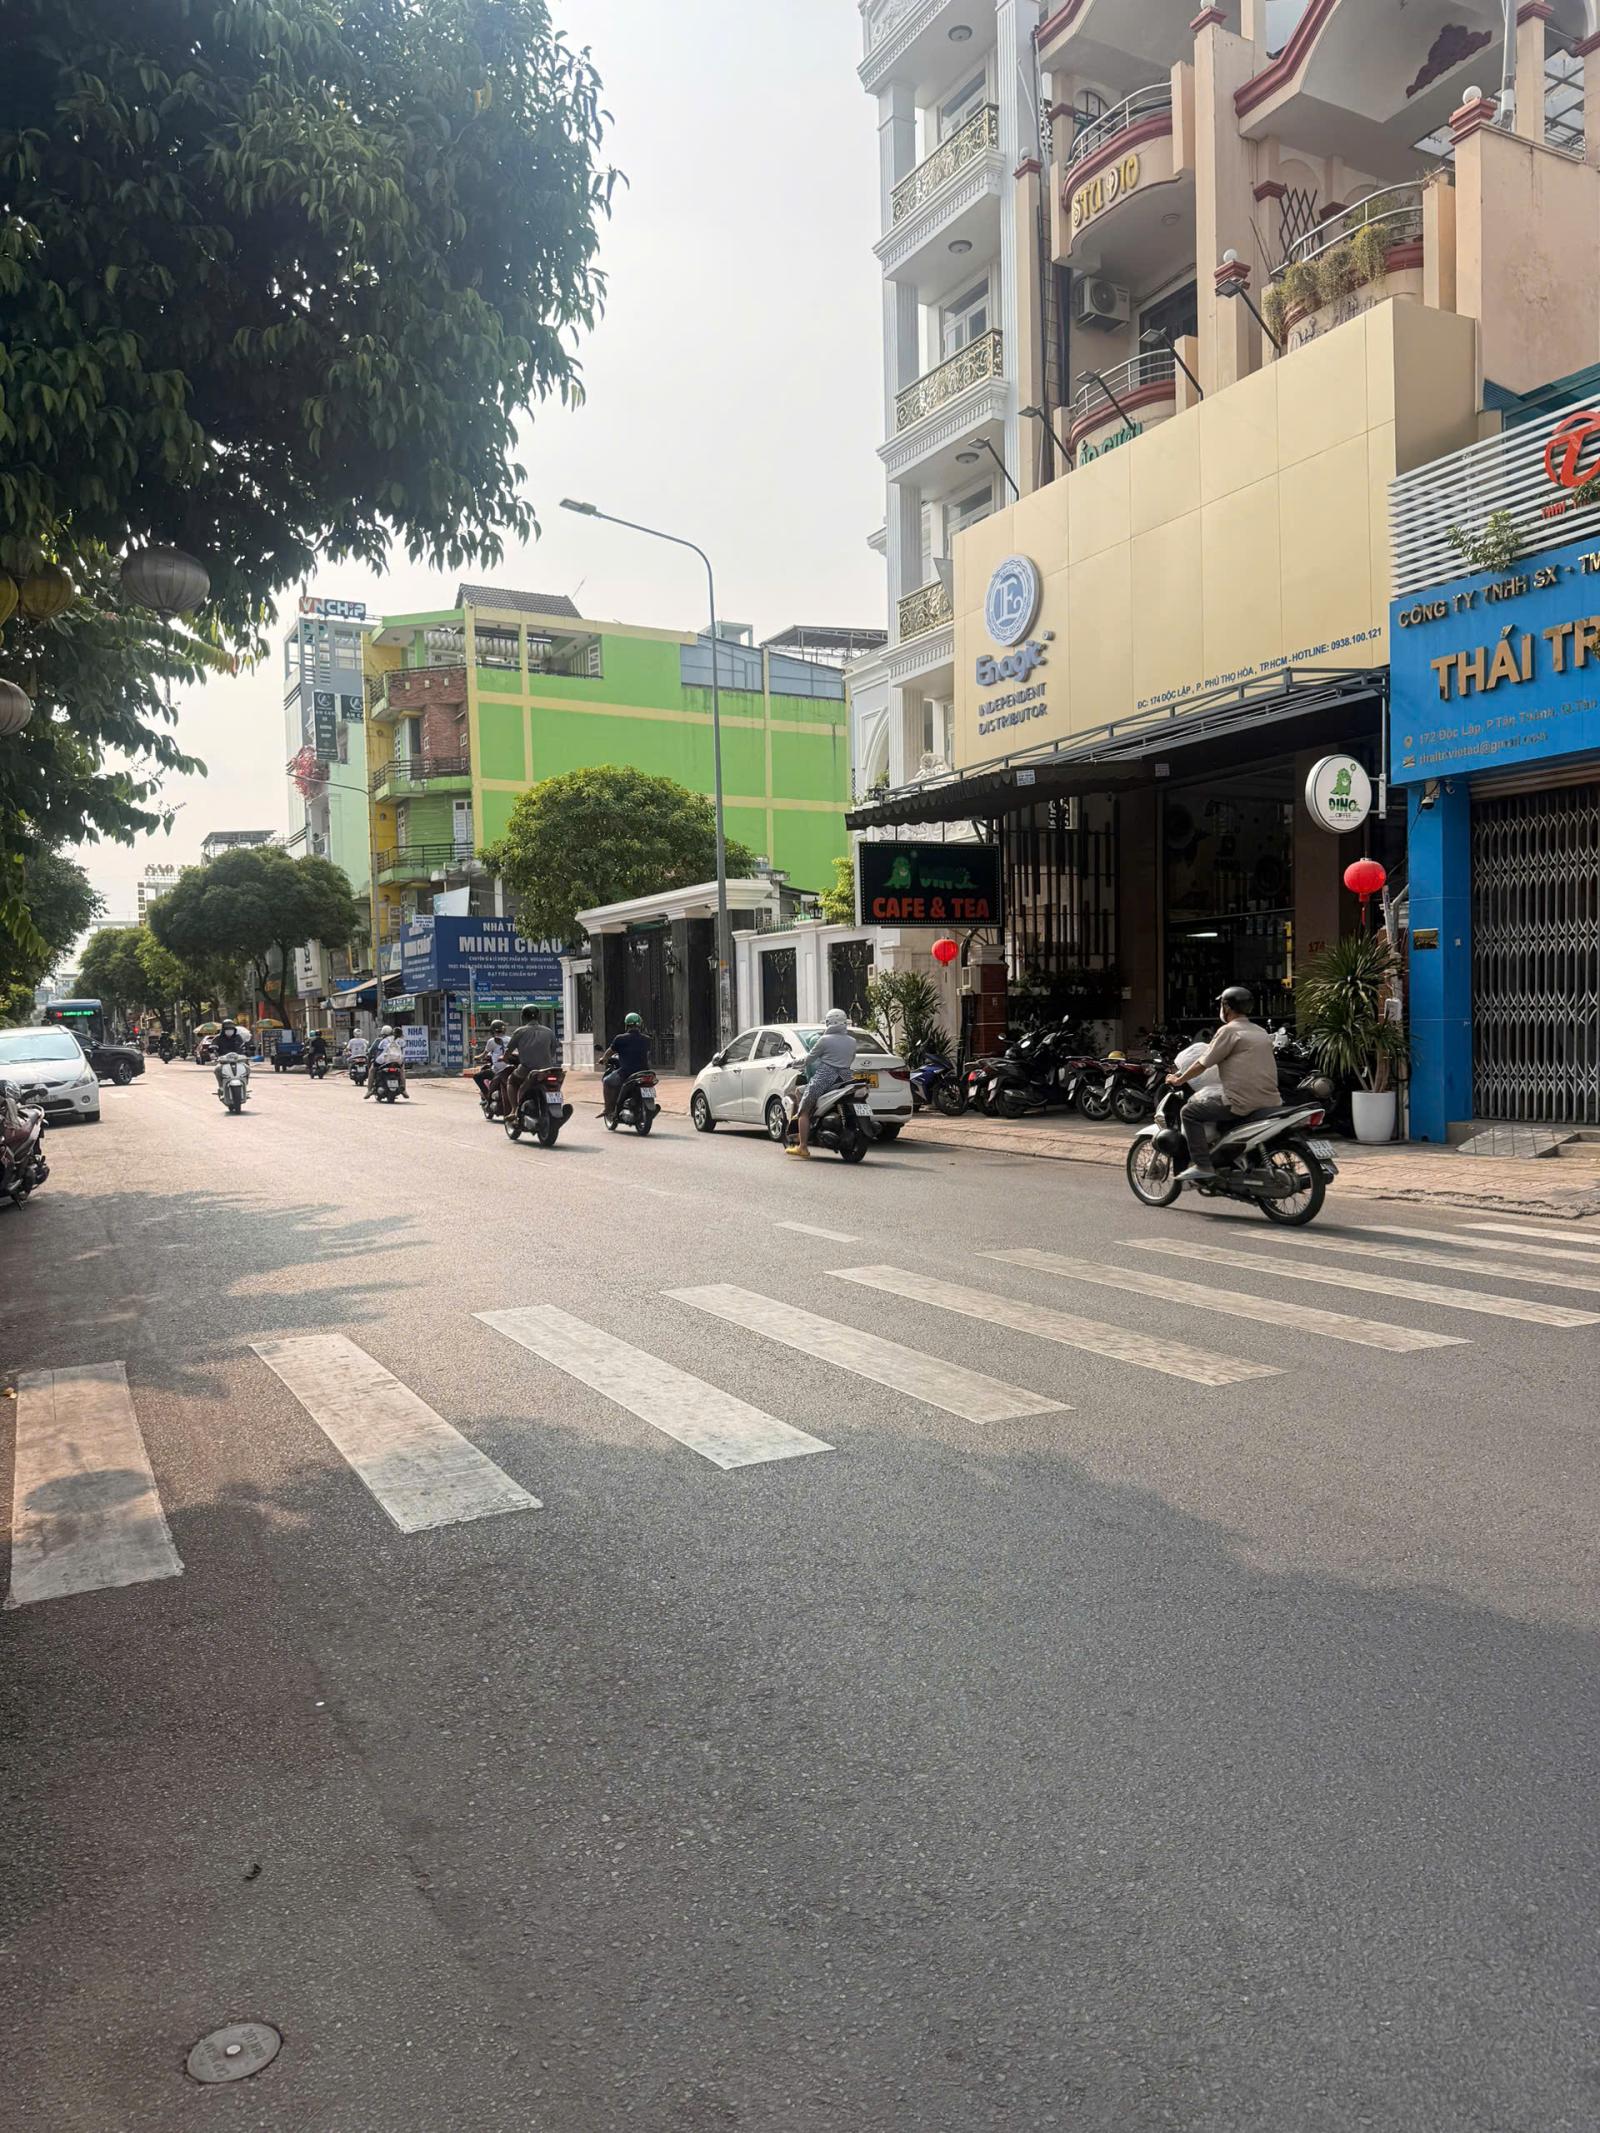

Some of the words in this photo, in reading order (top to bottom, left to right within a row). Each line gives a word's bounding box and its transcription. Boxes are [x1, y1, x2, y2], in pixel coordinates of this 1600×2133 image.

[1452, 590, 1476, 612] TY
[1482, 575, 1528, 604] TNHH
[1533, 564, 1560, 589] SX
[975, 640, 1049, 686] Enagic
[1150, 696, 1161, 705] 174
[1292, 644, 1330, 662] HOTLINE:
[1330, 627, 1382, 651] 0938.100.121
[1431, 623, 1534, 701] THÁI
[978, 682, 1047, 717] INDEPENDENT
[978, 703, 1048, 736] DISTRIBUTOR
[872, 897, 926, 919] CAFE
[930, 896, 947, 919] &
[952, 897, 990, 919] TEA
[459, 936, 510, 953] MINH
